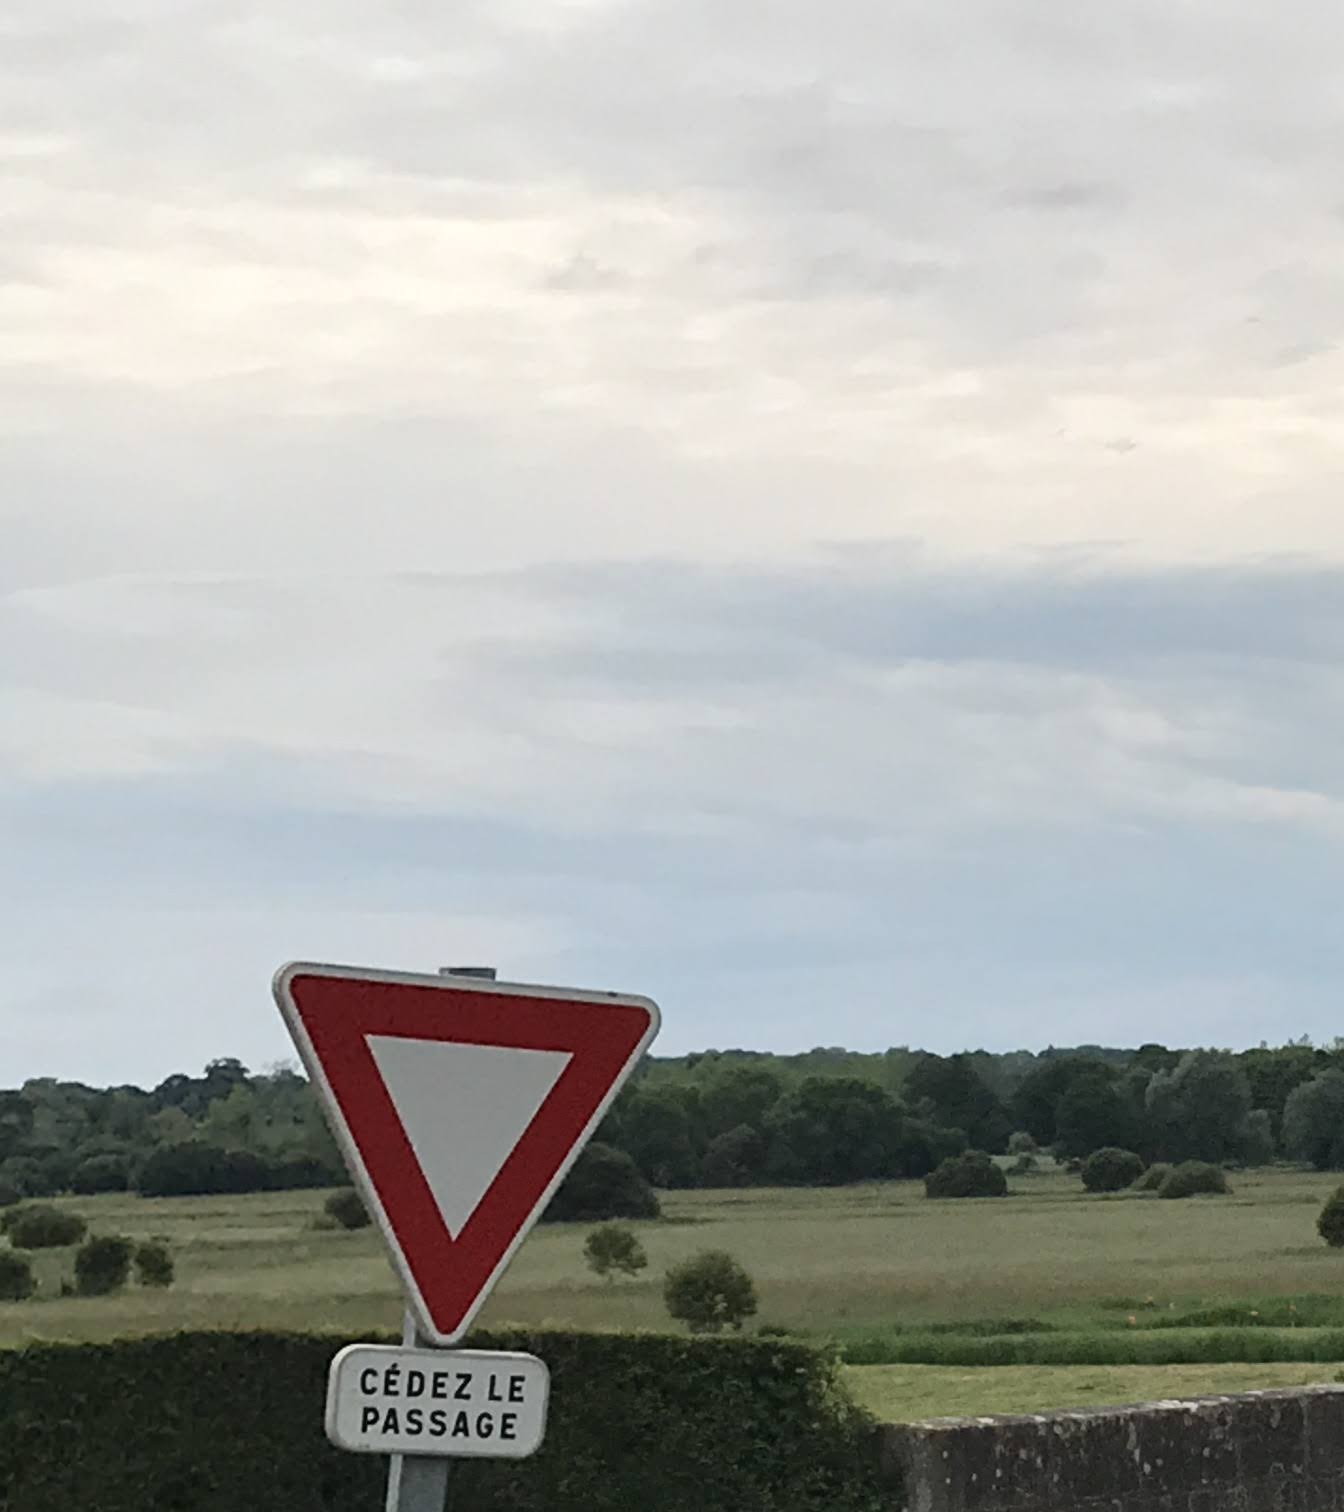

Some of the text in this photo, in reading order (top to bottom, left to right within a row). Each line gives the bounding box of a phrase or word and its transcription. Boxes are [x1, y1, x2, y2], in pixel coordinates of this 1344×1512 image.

[359, 1363, 526, 1403] CÉDEZ LE
[360, 1407, 519, 1440] PASSAGE
